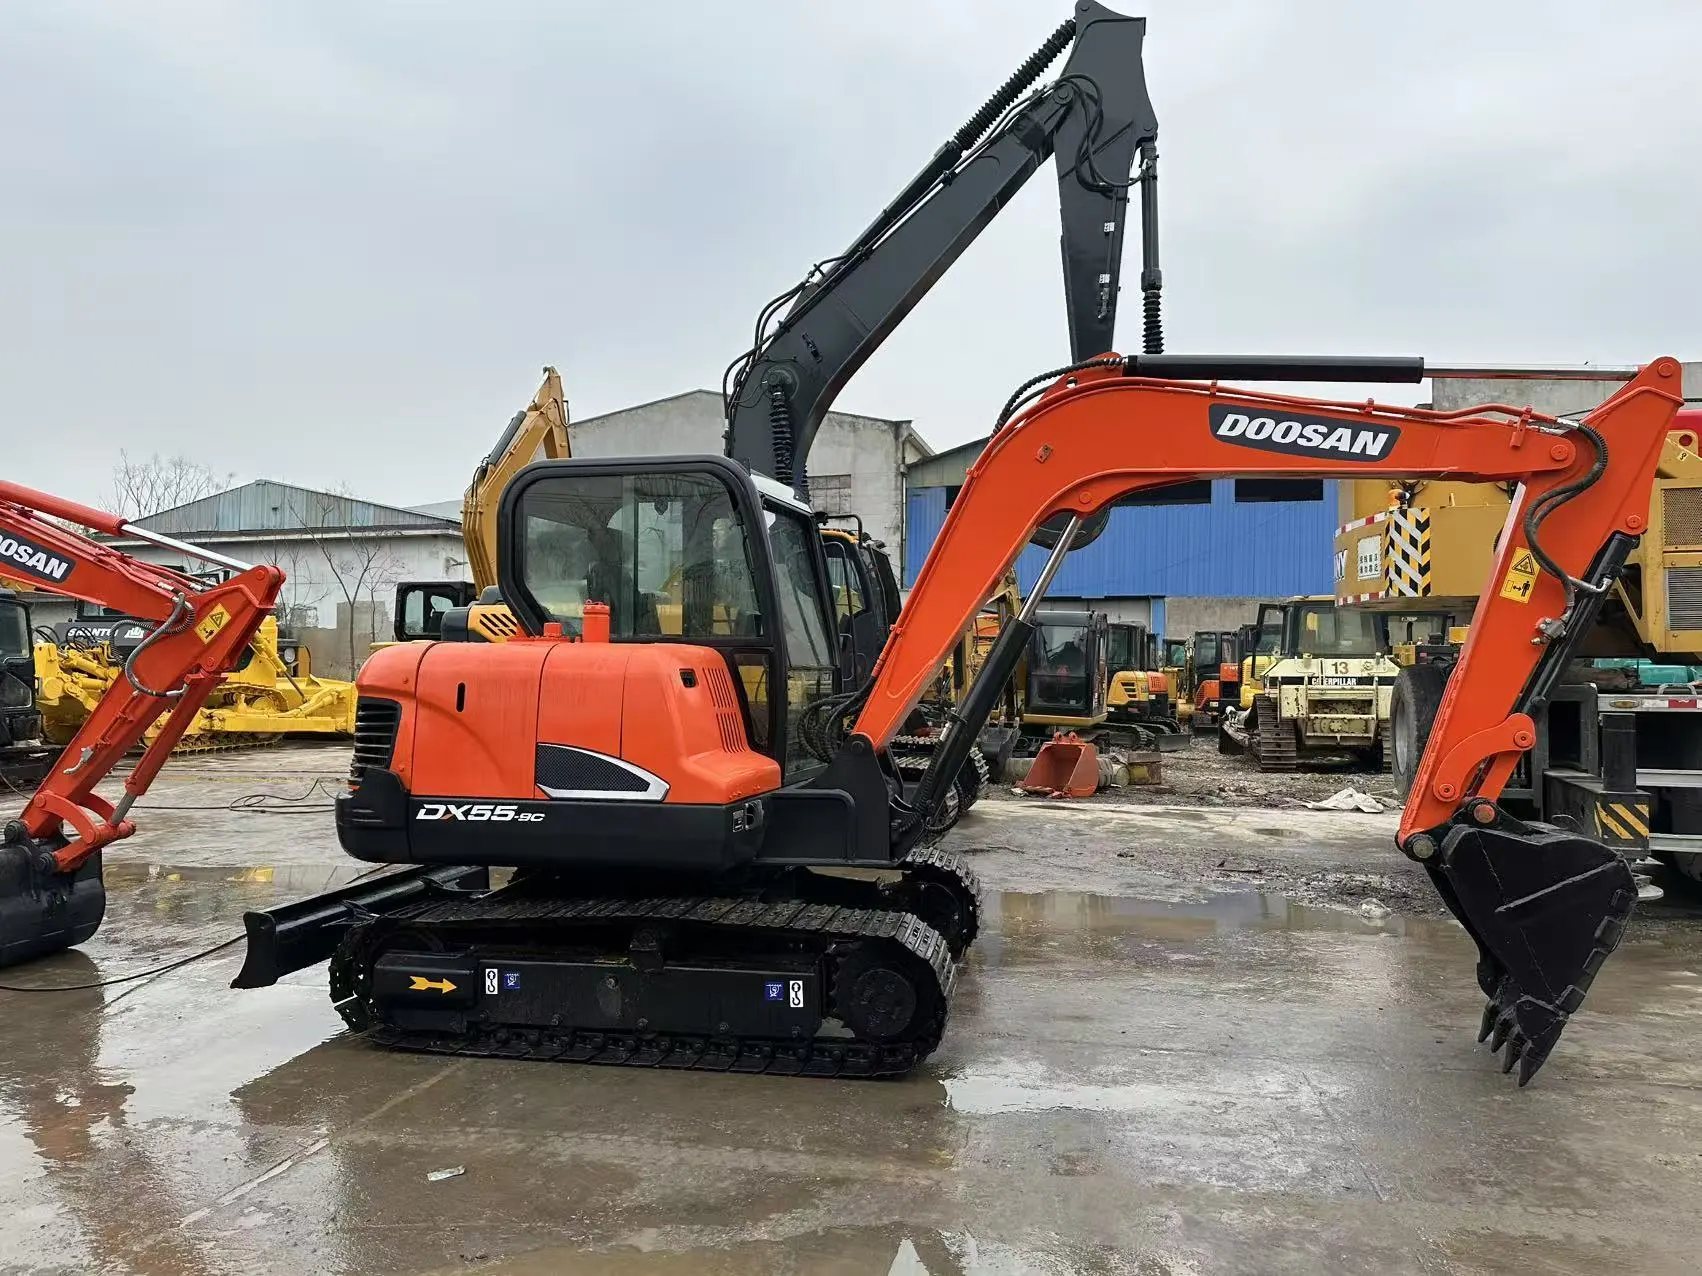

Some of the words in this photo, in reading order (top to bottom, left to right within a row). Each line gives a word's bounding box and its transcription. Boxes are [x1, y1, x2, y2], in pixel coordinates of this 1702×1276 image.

[1217, 414, 1389, 456] DOOSAN
[0, 535, 69, 579] OSAN
[1332, 661, 1349, 674] 13
[1312, 678, 1357, 686] CAERPILLAR
